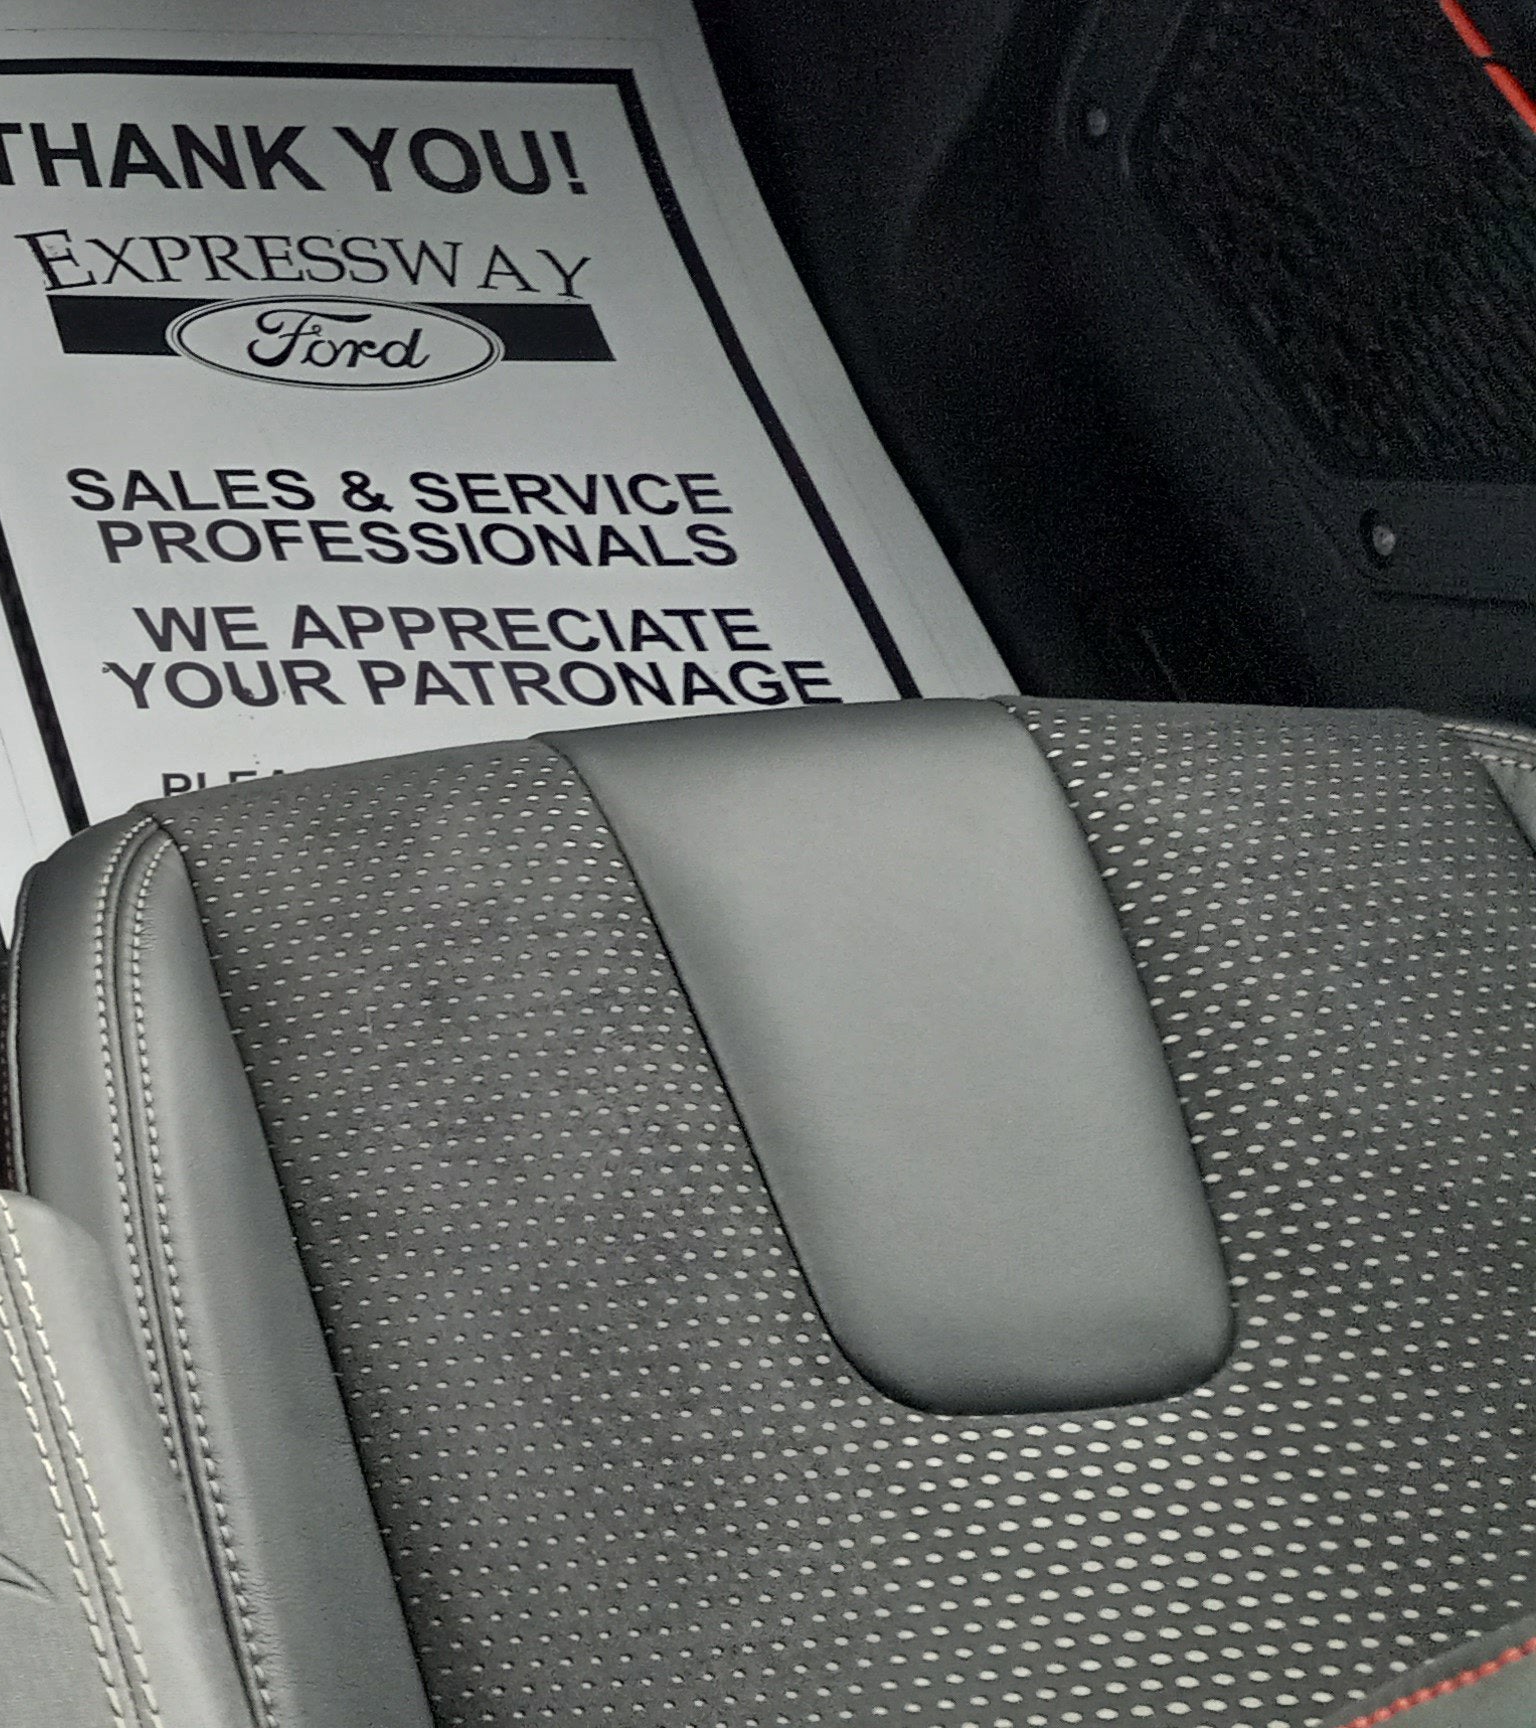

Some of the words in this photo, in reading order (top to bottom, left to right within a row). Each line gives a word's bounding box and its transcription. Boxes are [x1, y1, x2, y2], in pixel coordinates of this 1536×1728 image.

[331, 125, 588, 196] YOU!
[15, 227, 592, 300] EXPRESSWAY
[246, 307, 430, 370] Ford
[67, 468, 317, 515] SALES
[340, 469, 394, 513] &
[408, 471, 735, 519] SERVICE
[96, 519, 738, 568] PROFESSIONALS
[133, 606, 268, 653] WE
[291, 604, 776, 653] APPRECIATE
[103, 658, 352, 709] YOUR
[356, 659, 844, 709] PATRONAGE
